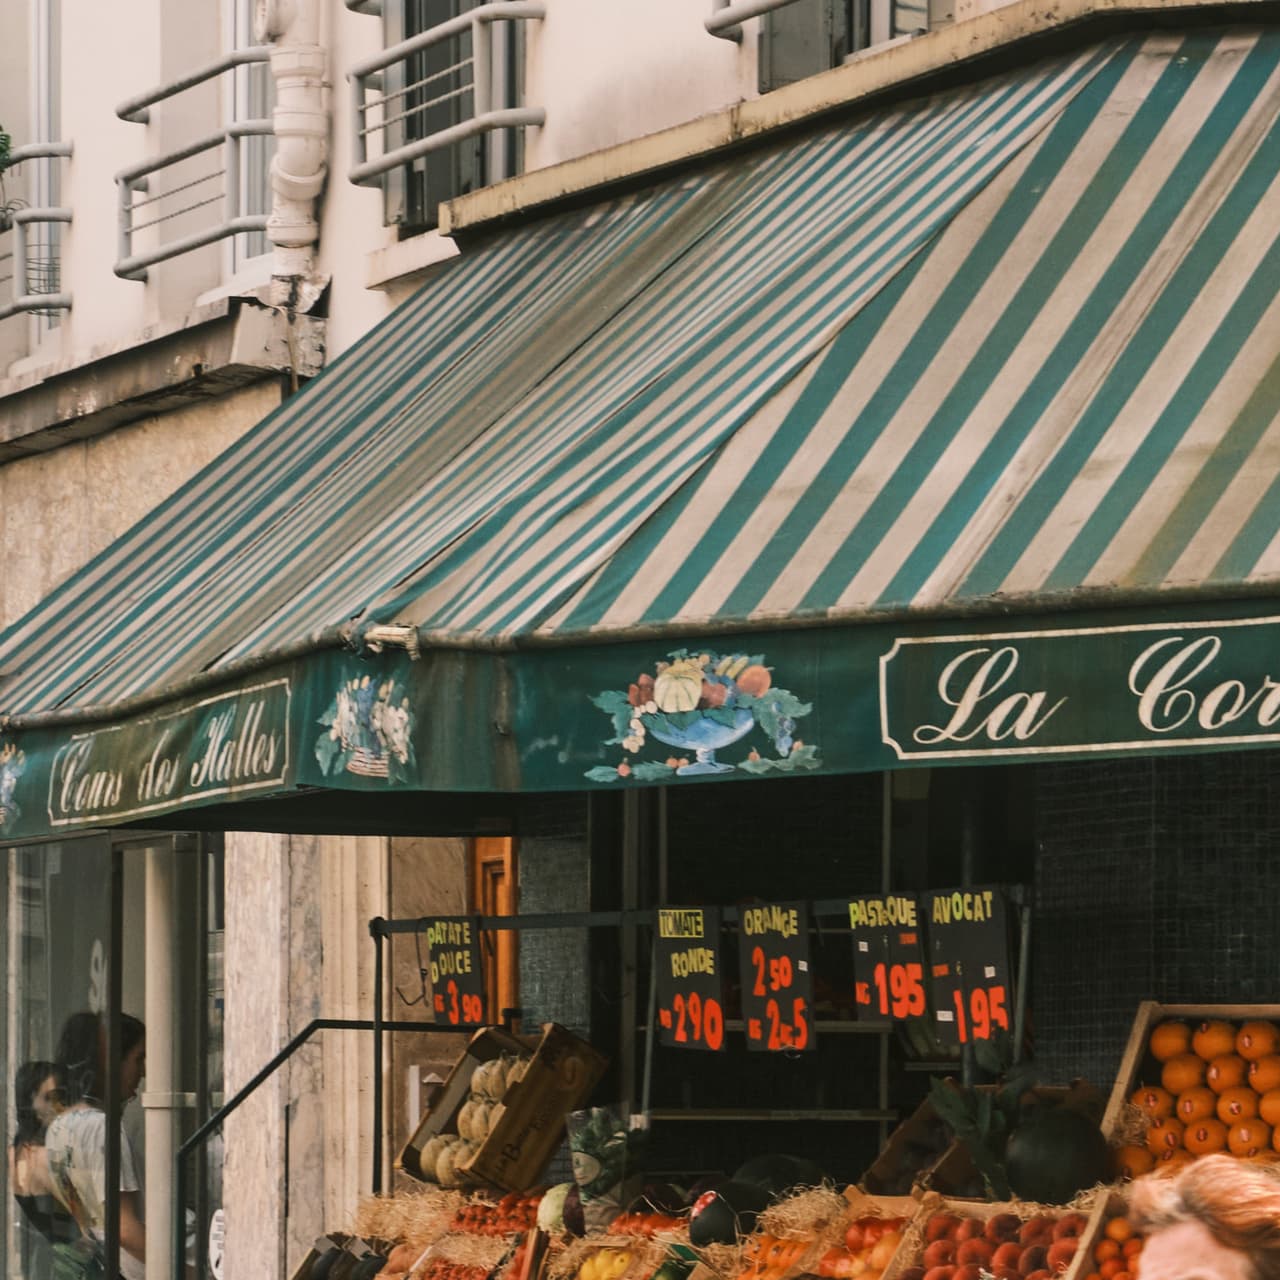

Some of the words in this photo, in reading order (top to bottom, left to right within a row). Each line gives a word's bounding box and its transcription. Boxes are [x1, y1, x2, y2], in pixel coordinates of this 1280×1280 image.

[914, 646, 1067, 745] La
[138, 728, 181, 802] des
[190, 700, 282, 788] Halles
[744, 905, 799, 939] ORANGE
[932, 891, 993, 925] AVOCAT
[427, 921, 471, 950] PATATE
[431, 949, 472, 984] DOUCE
[671, 947, 715, 978] RONDE
